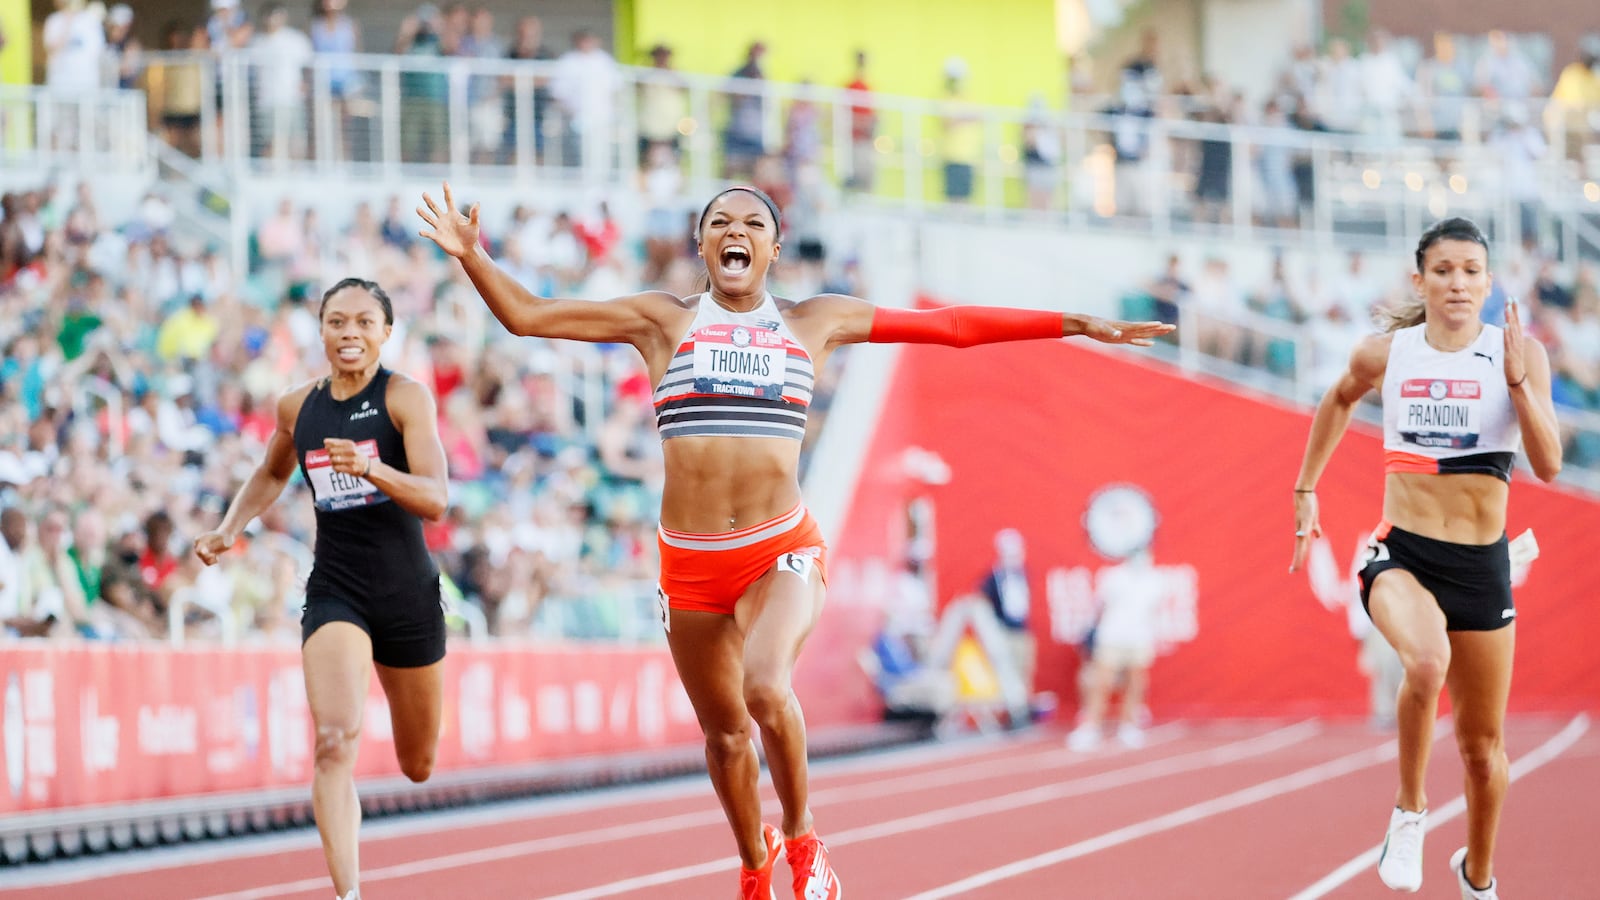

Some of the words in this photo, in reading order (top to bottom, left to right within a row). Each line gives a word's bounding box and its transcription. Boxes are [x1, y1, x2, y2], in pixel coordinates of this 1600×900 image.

[710, 349, 770, 377] THOMAS
[1407, 404, 1470, 428] PRANDINI
[329, 472, 363, 492] FELIX
